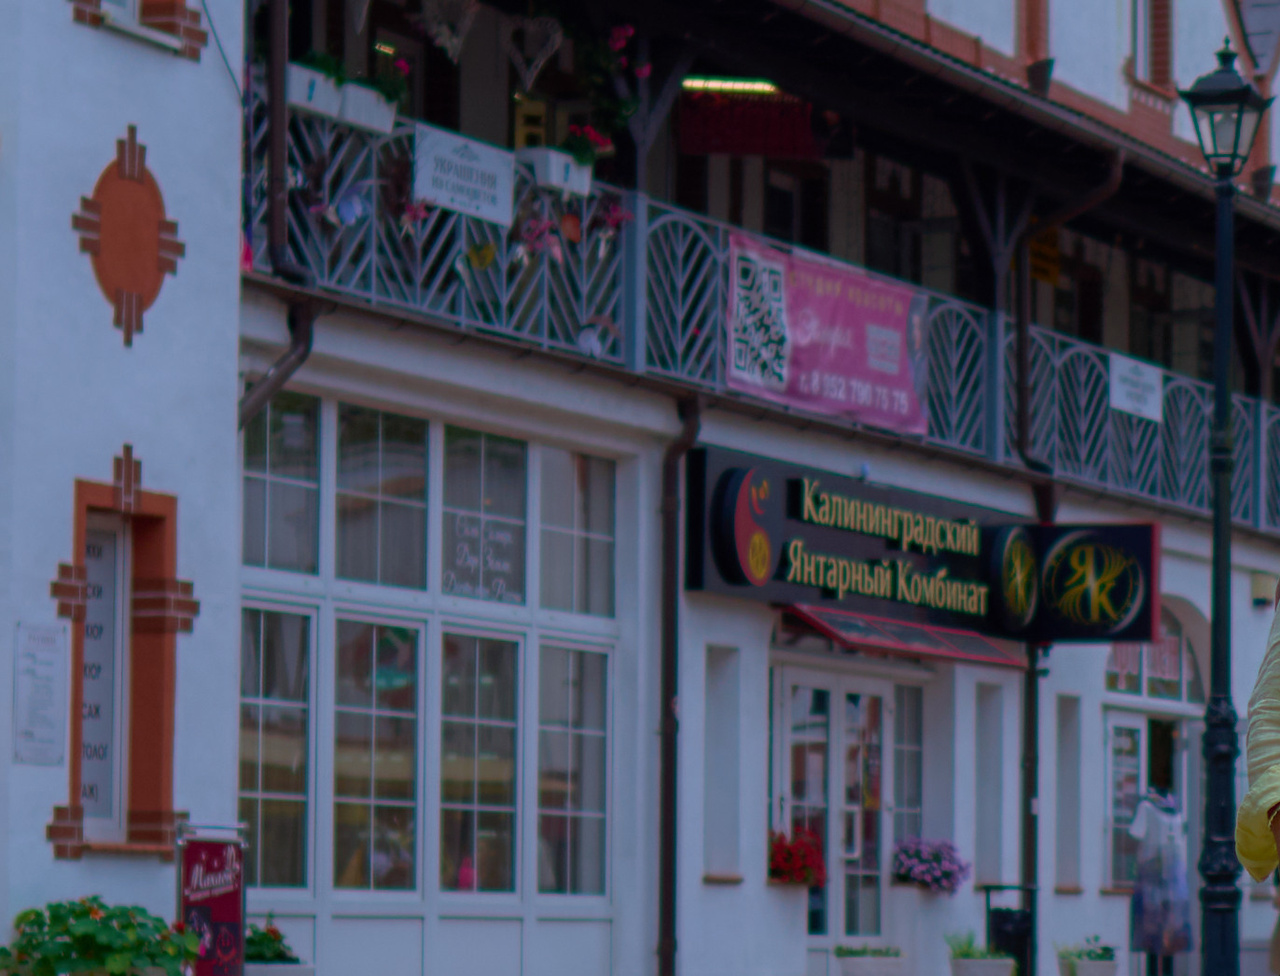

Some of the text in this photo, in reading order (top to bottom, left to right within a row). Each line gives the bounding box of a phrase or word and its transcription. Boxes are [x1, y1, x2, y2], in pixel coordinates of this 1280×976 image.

[433, 156, 497, 191] УКРАШЕНИЯ
[803, 478, 979, 556] Калининградский
[787, 539, 988, 617] Янтарный Комбинат
